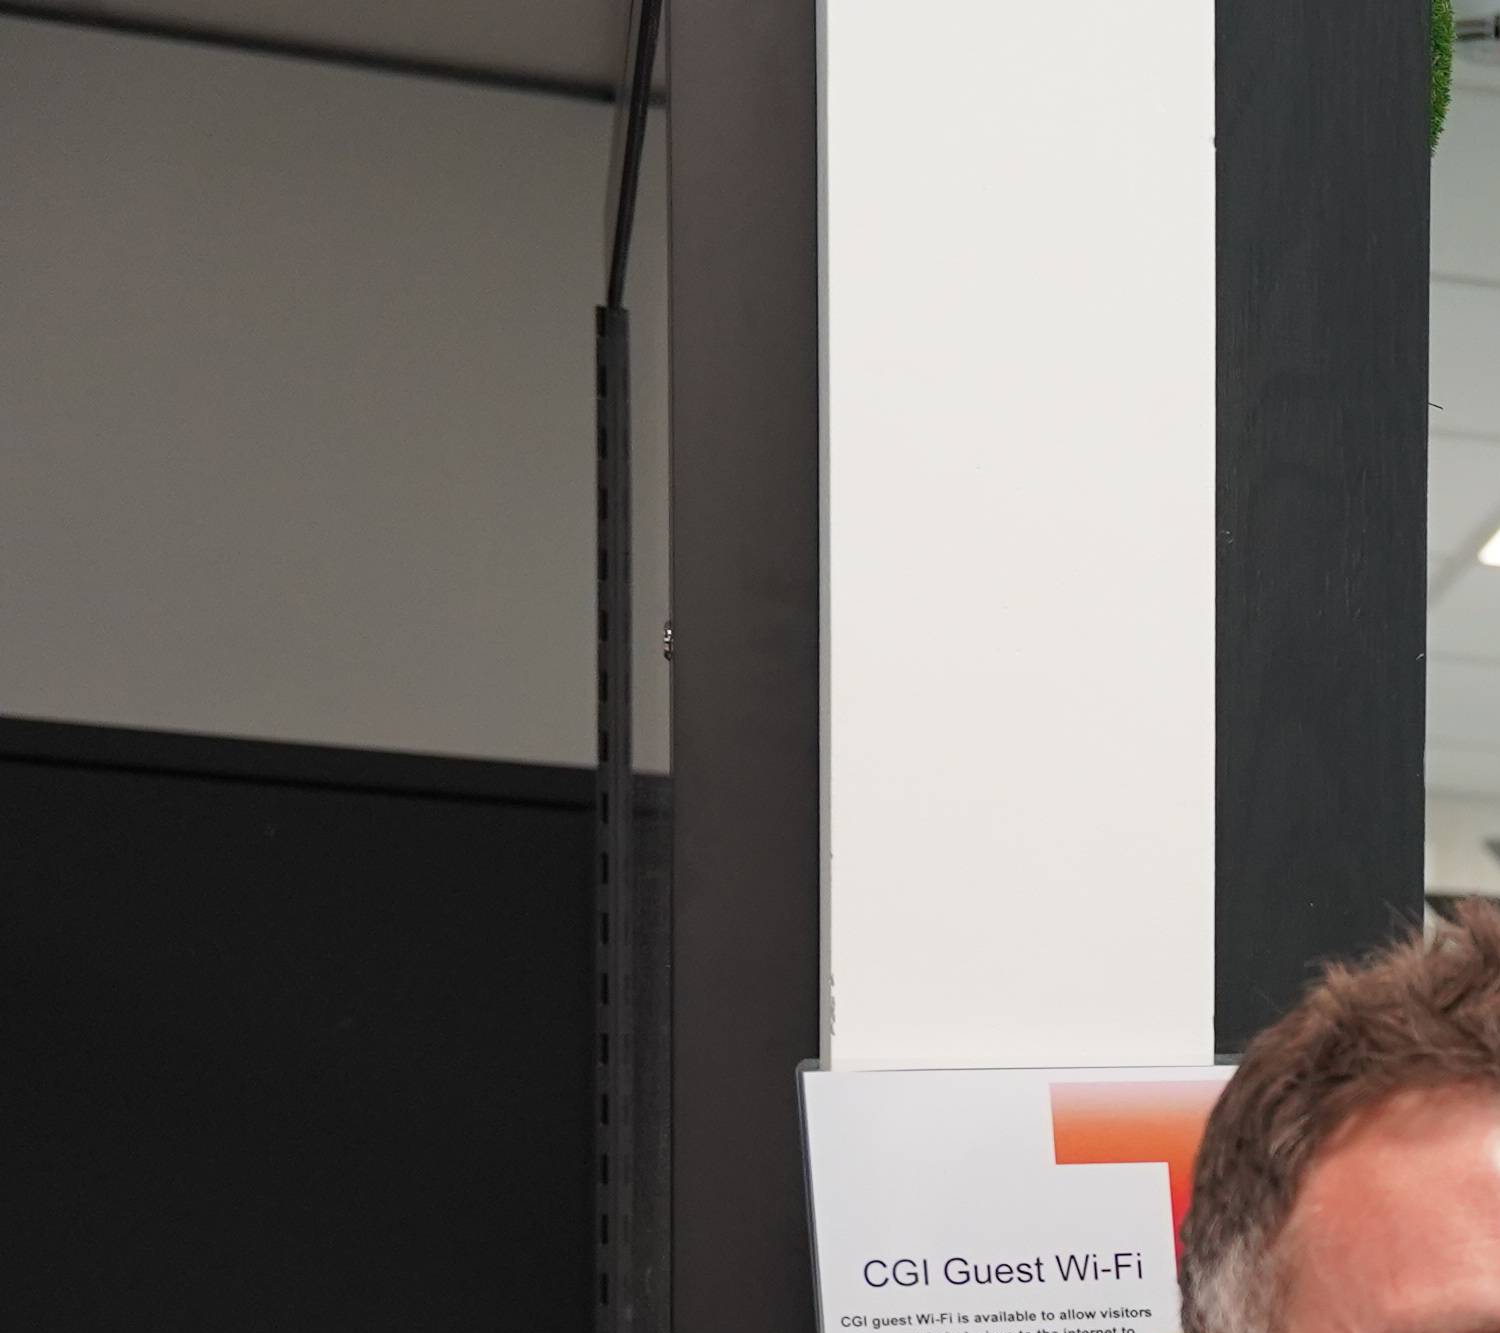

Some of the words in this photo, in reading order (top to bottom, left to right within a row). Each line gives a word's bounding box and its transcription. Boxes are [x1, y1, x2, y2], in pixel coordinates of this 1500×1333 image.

[862, 1257, 929, 1288] CGI
[943, 1254, 1045, 1286] Guest
[1054, 1251, 1142, 1282] Wi-Fi
[840, 1315, 867, 1328] CGI
[871, 1314, 912, 1330] guest
[915, 1312, 952, 1325] Wi-Fi
[957, 1312, 970, 1324] is
[973, 1309, 1037, 1323] available
[1040, 1310, 1055, 1321] to
[1058, 1307, 1096, 1320] allow
[1099, 1305, 1152, 1321] visitors
